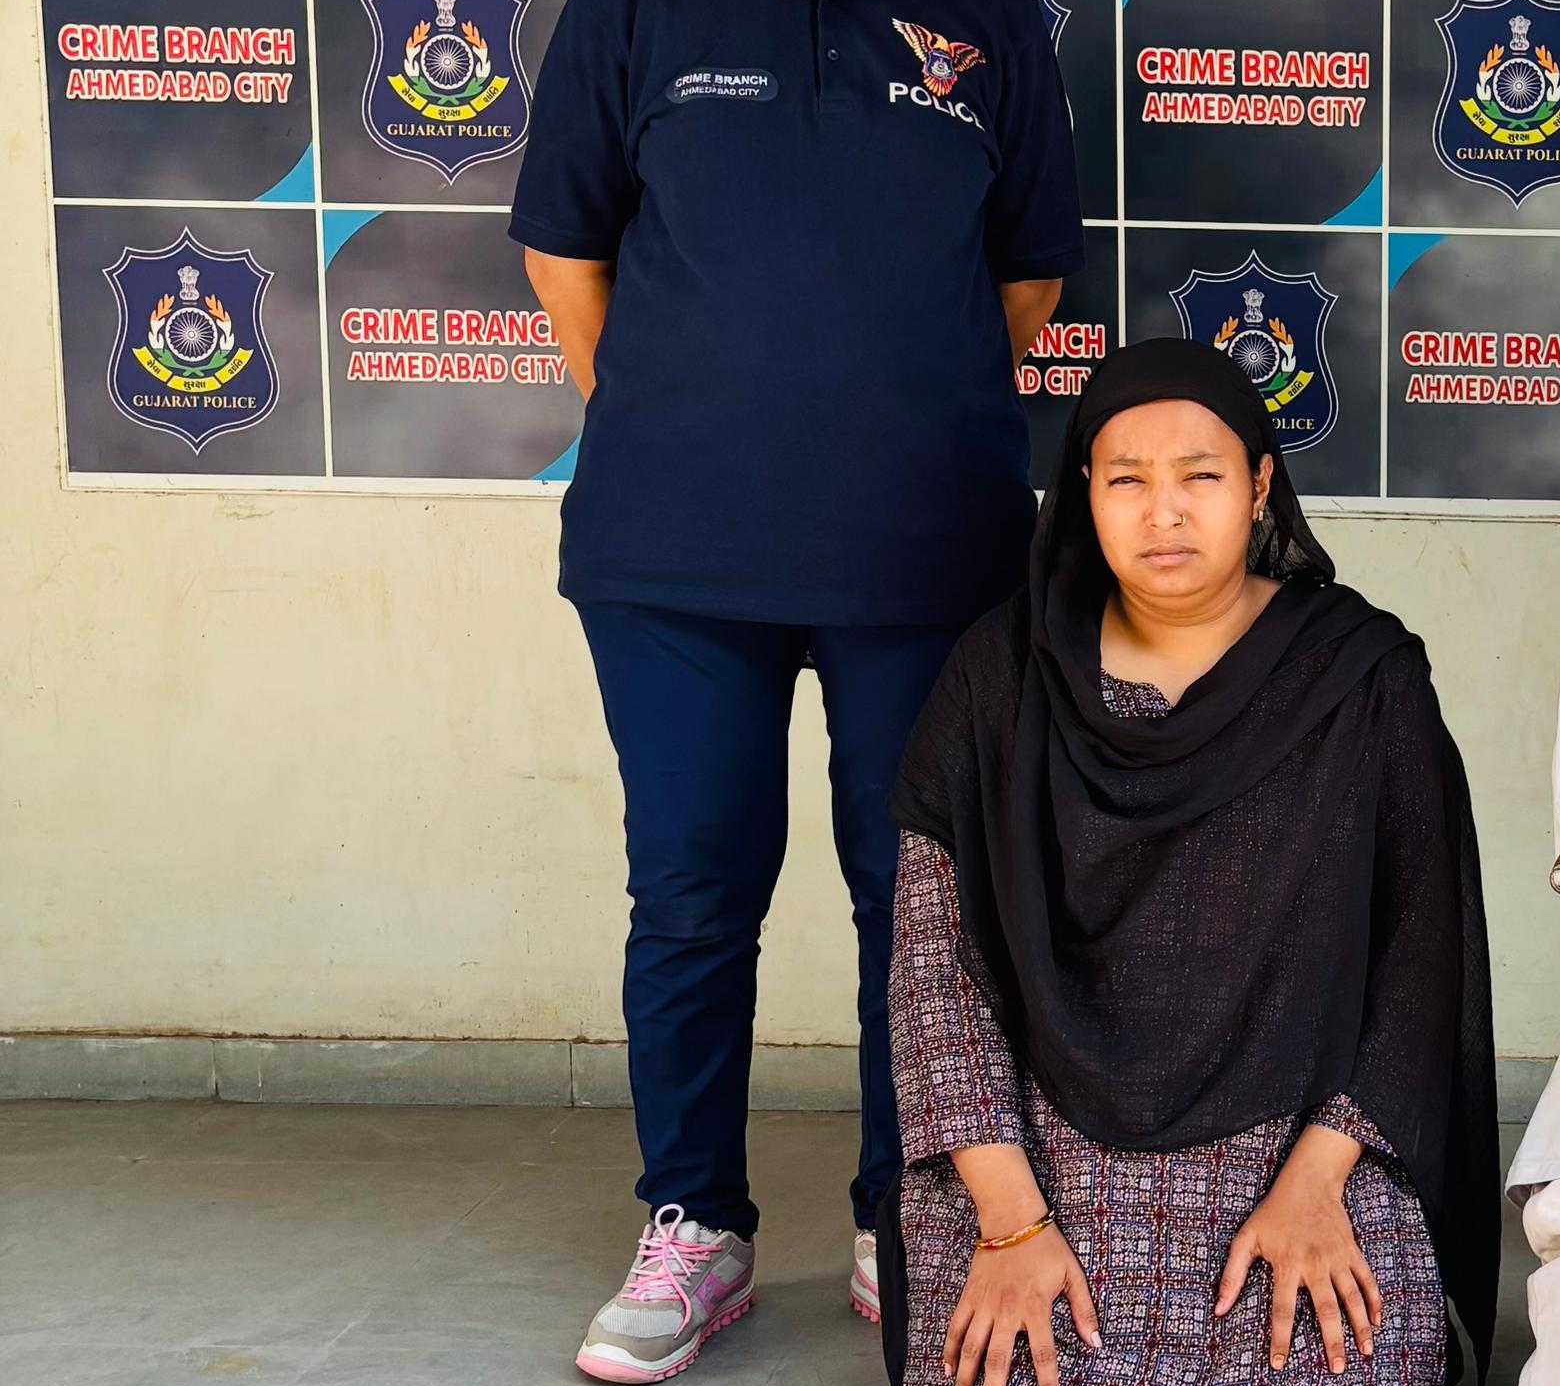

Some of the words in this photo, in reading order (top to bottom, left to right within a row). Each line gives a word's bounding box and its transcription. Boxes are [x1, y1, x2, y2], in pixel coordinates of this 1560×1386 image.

[58, 24, 159, 61] CRIME
[164, 27, 296, 64] BRANCH
[675, 73, 711, 87] CRIME
[714, 74, 768, 86] BRANCH
[1136, 47, 1236, 86] CRIME
[1241, 50, 1370, 88] BRANCH
[66, 69, 231, 102] AHMEDABAD
[234, 72, 292, 103] CITY
[738, 88, 760, 96] CITY
[1142, 92, 1305, 125] AHMEDABAD
[1307, 96, 1365, 126] CITY
[386, 123, 456, 137] GUJARAT
[459, 125, 512, 138] POLICE
[1456, 147, 1523, 160] GUJARAT
[340, 308, 439, 344] CRIME
[1024, 323, 1106, 359] ANCH
[1400, 331, 1496, 368] CRIME
[347, 352, 509, 386] AHMEDABAD
[511, 354, 567, 383] CITY
[132, 394, 200, 408] GUJARAT
[203, 396, 257, 409] POLICE
[1272, 418, 1315, 430] OLICE
